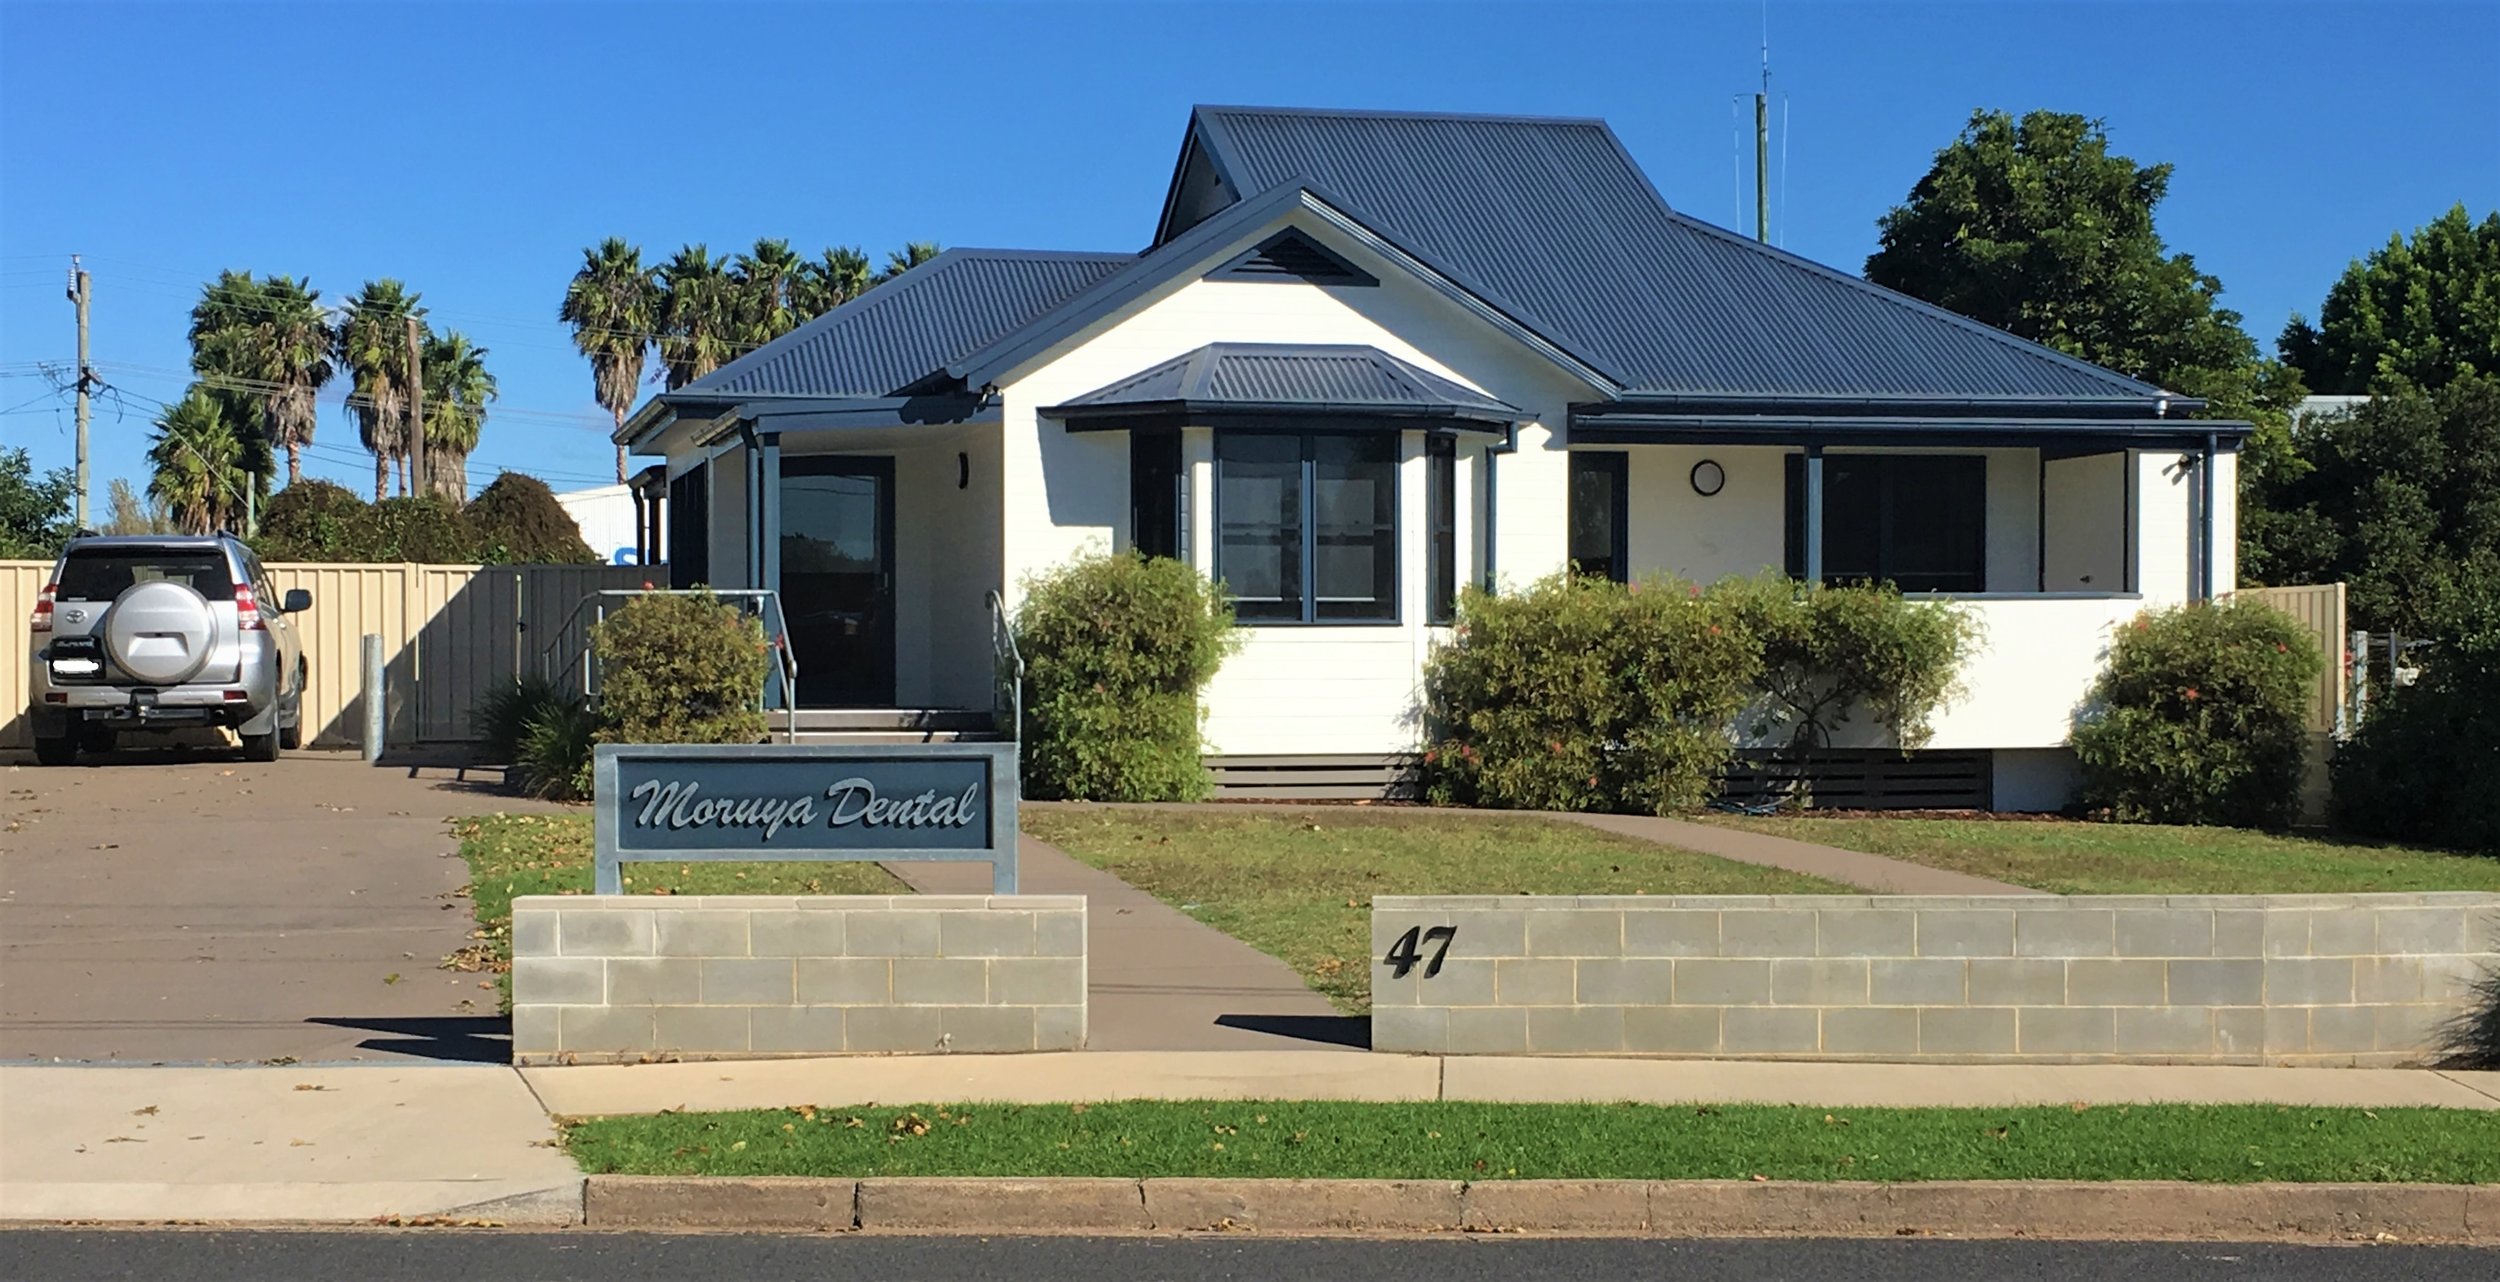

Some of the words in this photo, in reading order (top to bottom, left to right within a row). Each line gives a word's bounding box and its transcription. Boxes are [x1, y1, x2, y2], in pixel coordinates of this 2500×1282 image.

[632, 779, 819, 840] Moruya
[828, 777, 979, 826] Dental
[1383, 925, 1458, 979] 47
